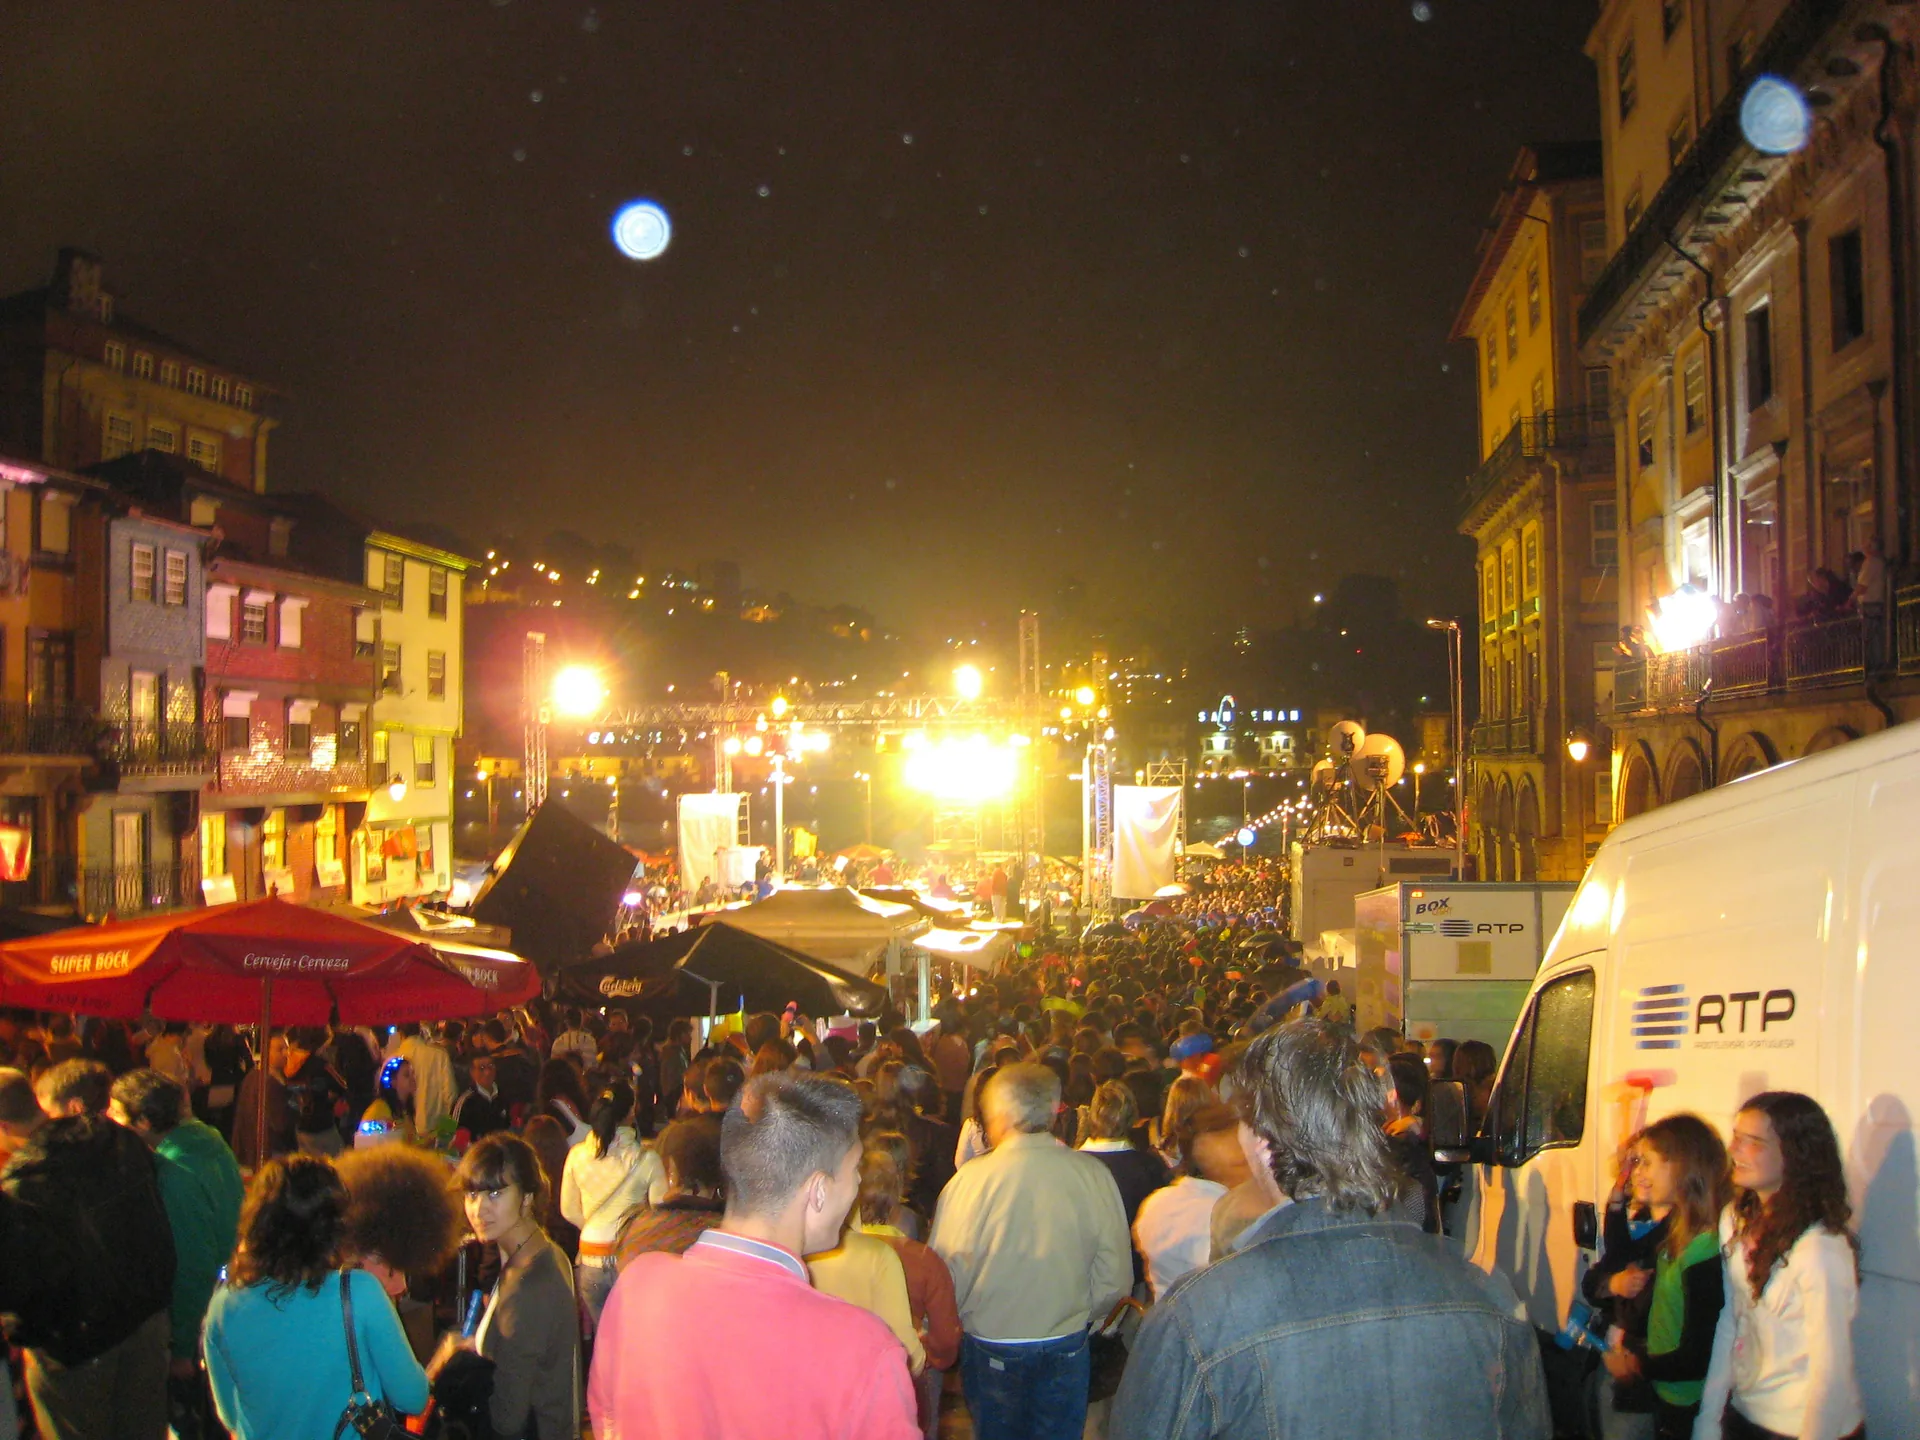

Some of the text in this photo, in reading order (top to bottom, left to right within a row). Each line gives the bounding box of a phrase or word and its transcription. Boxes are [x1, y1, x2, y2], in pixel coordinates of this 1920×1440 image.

[1198, 709, 1300, 723] SANEMAN
[1416, 897, 1450, 914] BOX
[1476, 923, 1525, 934] RTP
[50, 950, 131, 975] SUPER BOCK
[244, 953, 350, 970] Cerveja Cerveza
[1695, 989, 1796, 1034] RTP
